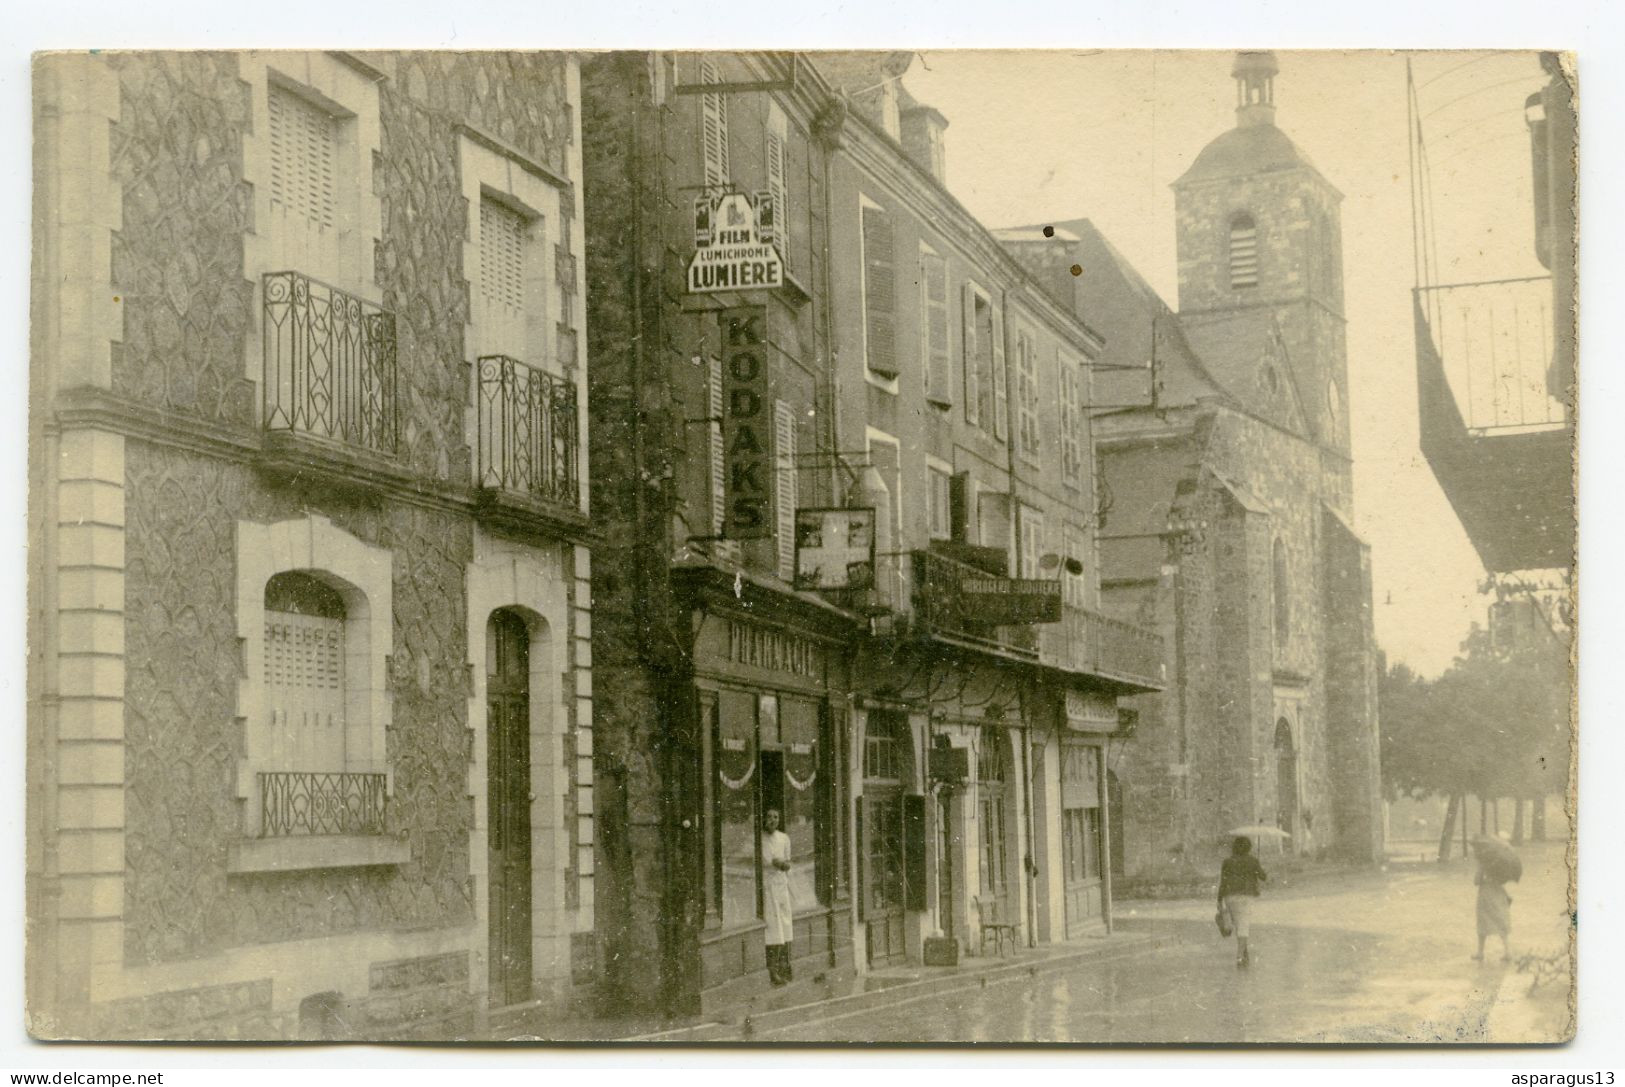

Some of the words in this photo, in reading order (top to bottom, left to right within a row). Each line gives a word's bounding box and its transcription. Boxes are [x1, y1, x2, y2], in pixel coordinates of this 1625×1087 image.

[701, 246, 770, 261] LUMICHROME
[719, 230, 750, 244] FILM
[729, 315, 764, 528] KODAKS
[731, 621, 816, 677] PHARMACIE
